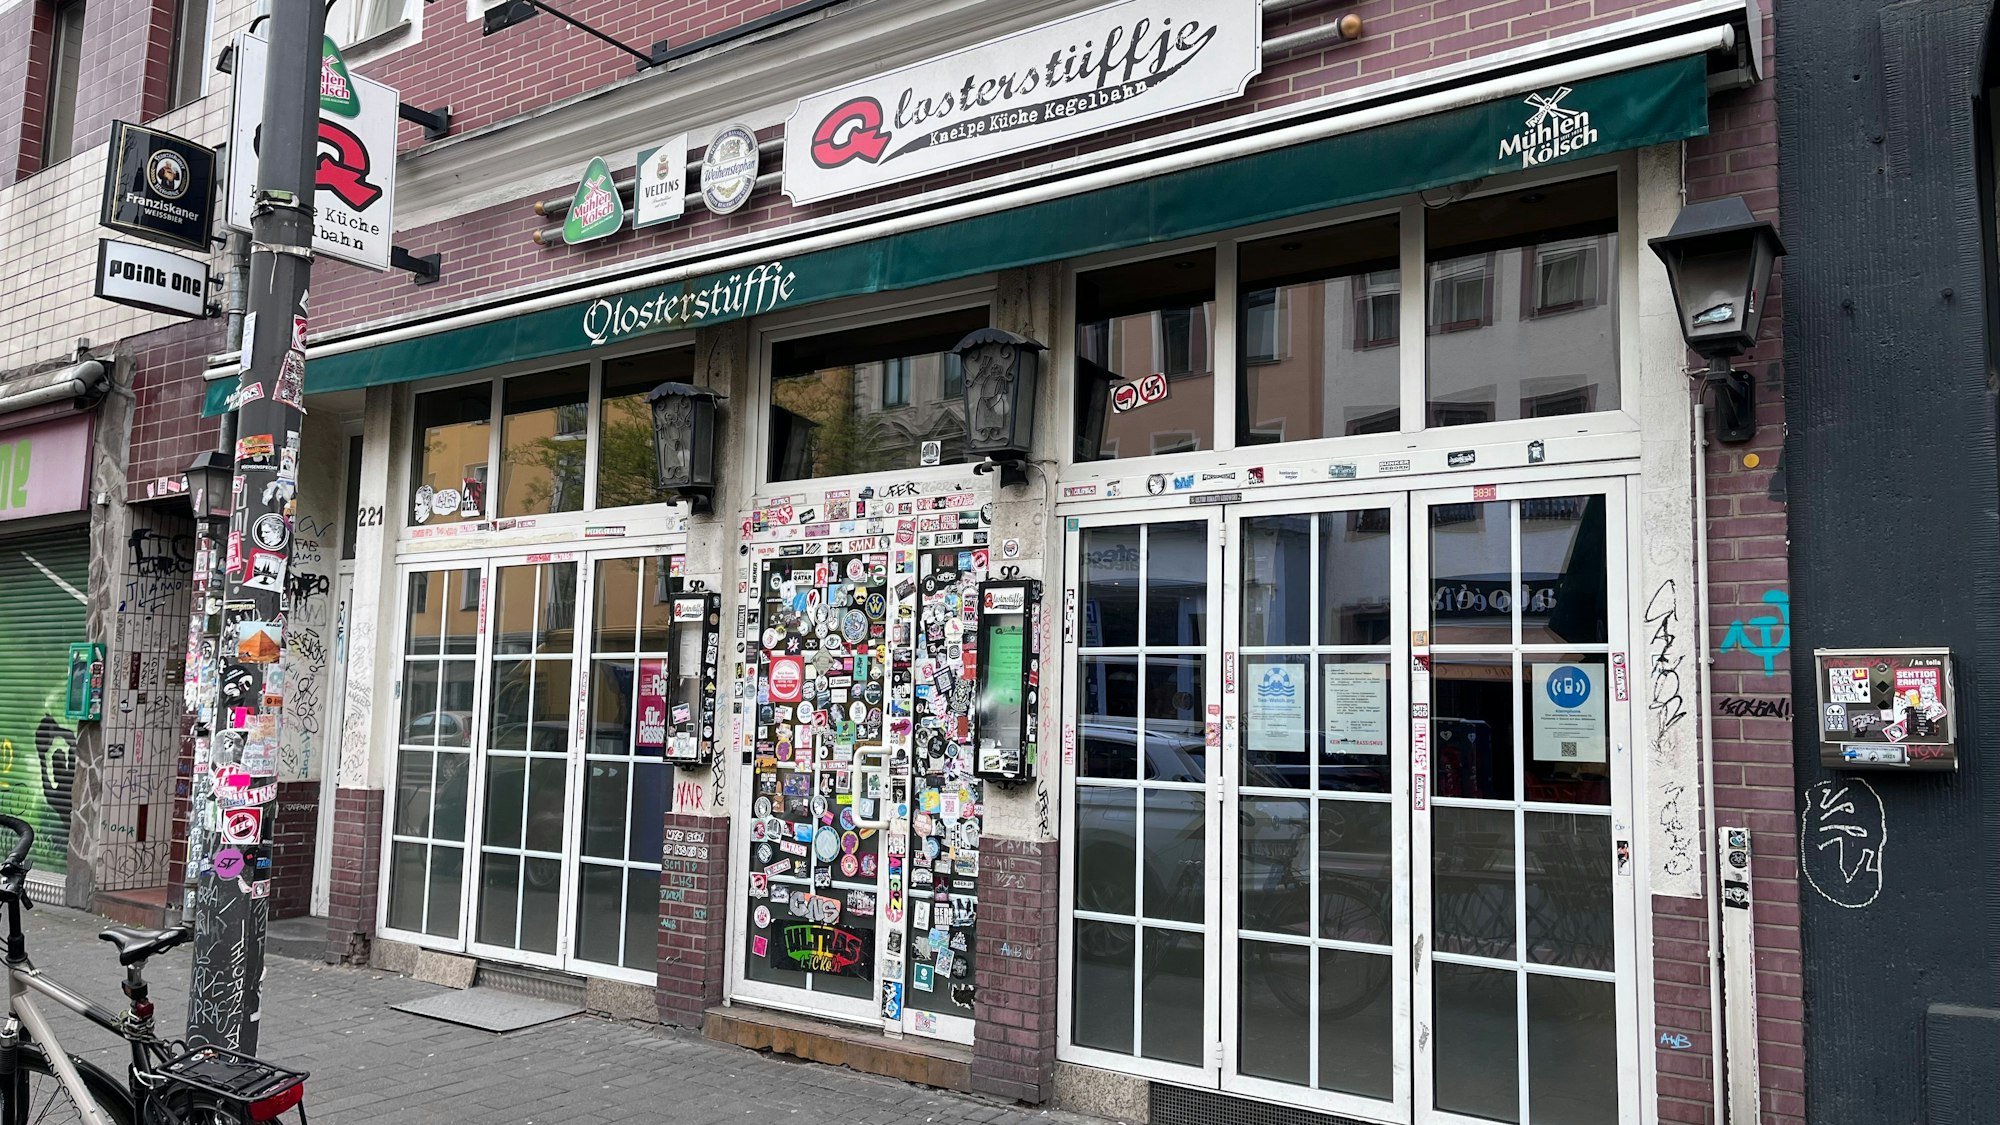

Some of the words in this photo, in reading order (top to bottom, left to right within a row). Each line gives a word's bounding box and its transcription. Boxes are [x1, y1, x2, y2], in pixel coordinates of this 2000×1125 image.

[929, 120, 986, 147] Kneipe
[988, 107, 1039, 134] Küche
[1043, 80, 1148, 121] Kegelbahn
[1498, 111, 1590, 160] Mühlen
[1522, 126, 1598, 169] Kölsch
[704, 159, 756, 182] Weihenstephan
[644, 179, 680, 198] VELTINS
[126, 192, 200, 222] Franziskaner
[144, 207, 183, 225] WEISSBIER
[573, 191, 611, 219] Mühlen
[581, 201, 614, 228] Kölsch
[324, 207, 380, 236] Küche
[358, 505, 384, 527] 221
[645, 706, 660, 726] für
[784, 924, 862, 965] ULTRAS
[1660, 1032, 1692, 1049] AWB
